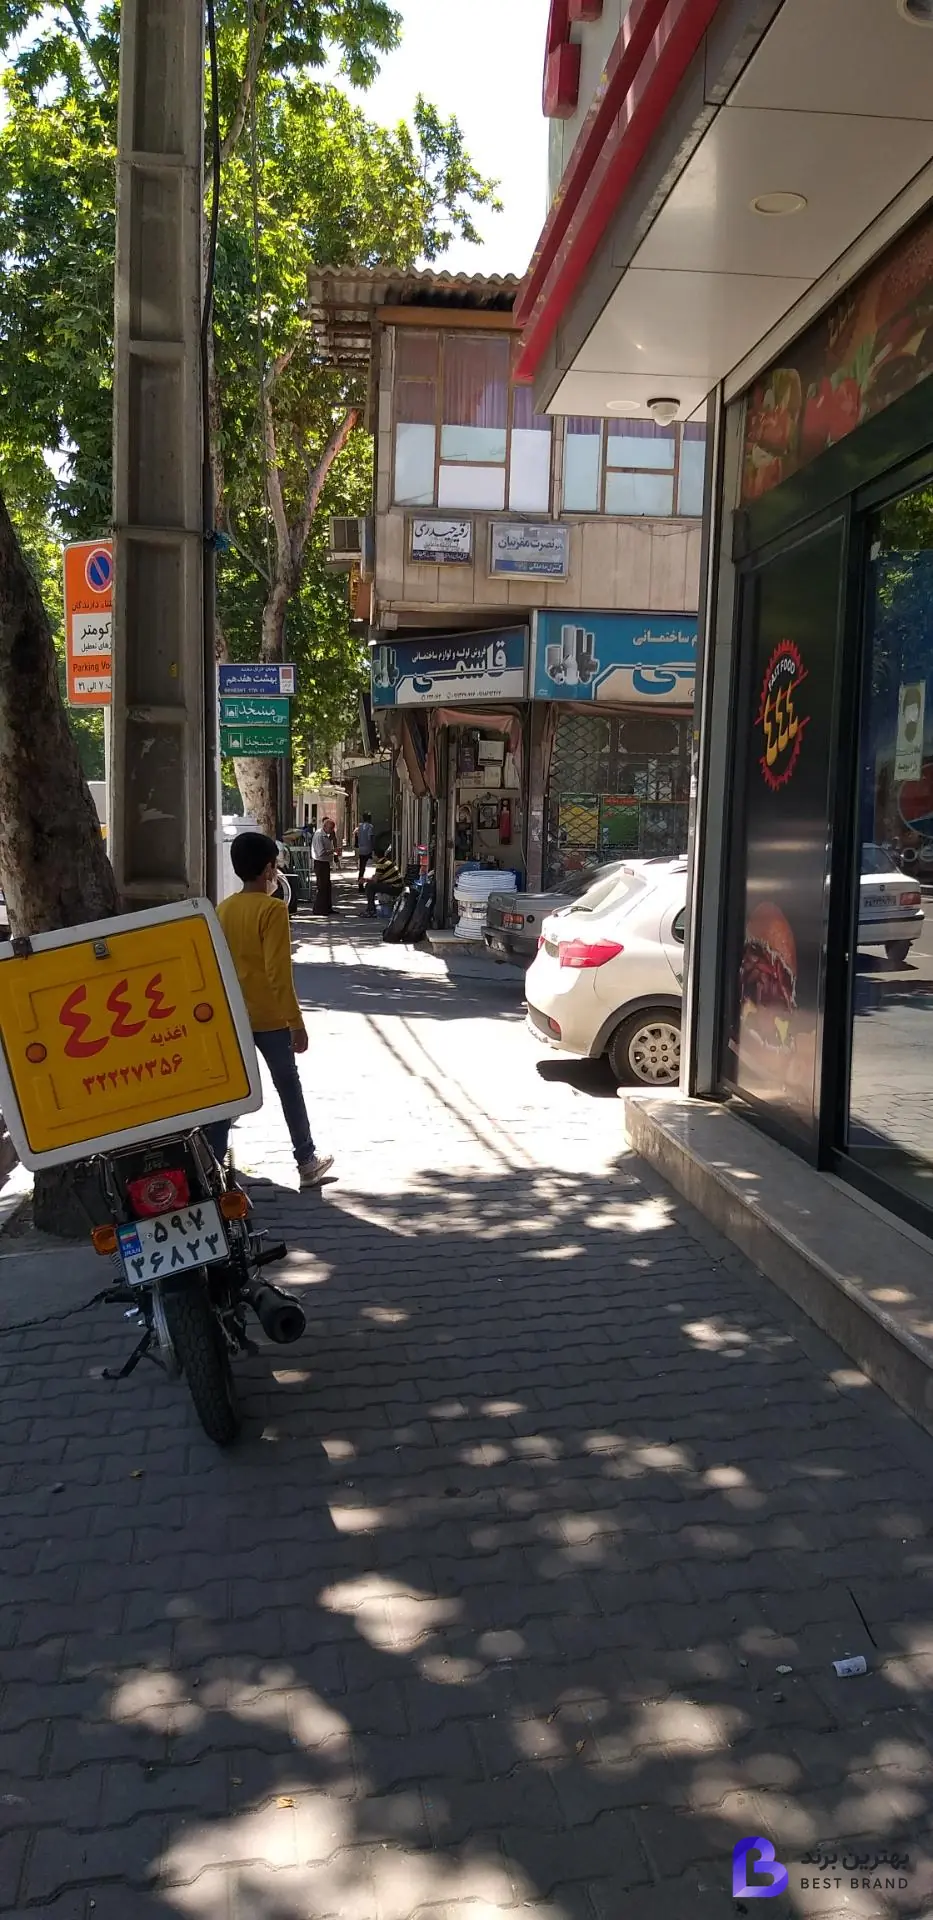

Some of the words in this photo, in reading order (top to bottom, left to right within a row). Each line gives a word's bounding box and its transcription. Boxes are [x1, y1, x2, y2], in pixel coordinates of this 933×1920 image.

[414, 523, 457, 541] حیدری
[451, 523, 469, 543] رقیه
[530, 538, 555, 551] نصرت
[80, 622, 112, 641] کومتر
[632, 629, 690, 646] ساختمانی
[411, 650, 438, 663] ساختمانی
[438, 649, 452, 662] لوازم
[456, 646, 470, 658] لوله
[470, 646, 487, 659] فروش
[73, 663, 99, 673] Parking
[412, 640, 507, 693] قاسمی
[225, 673, 253, 686] هفدهم
[252, 673, 278, 685] بهشت
[767, 663, 780, 693] FAST
[779, 658, 796, 675] FOOD
[238, 700, 277, 719] مسجد
[244, 735, 275, 749] مسجد
[150, 1023, 188, 1047] اغذیه
[82, 1053, 183, 1096] ۳۲۲۲۷۳۵۶
[153, 1207, 203, 1244] ۵۹۷
[124, 1246, 142, 1258] IRAN
[130, 1232, 219, 1280] ۳۶۸۲۳
